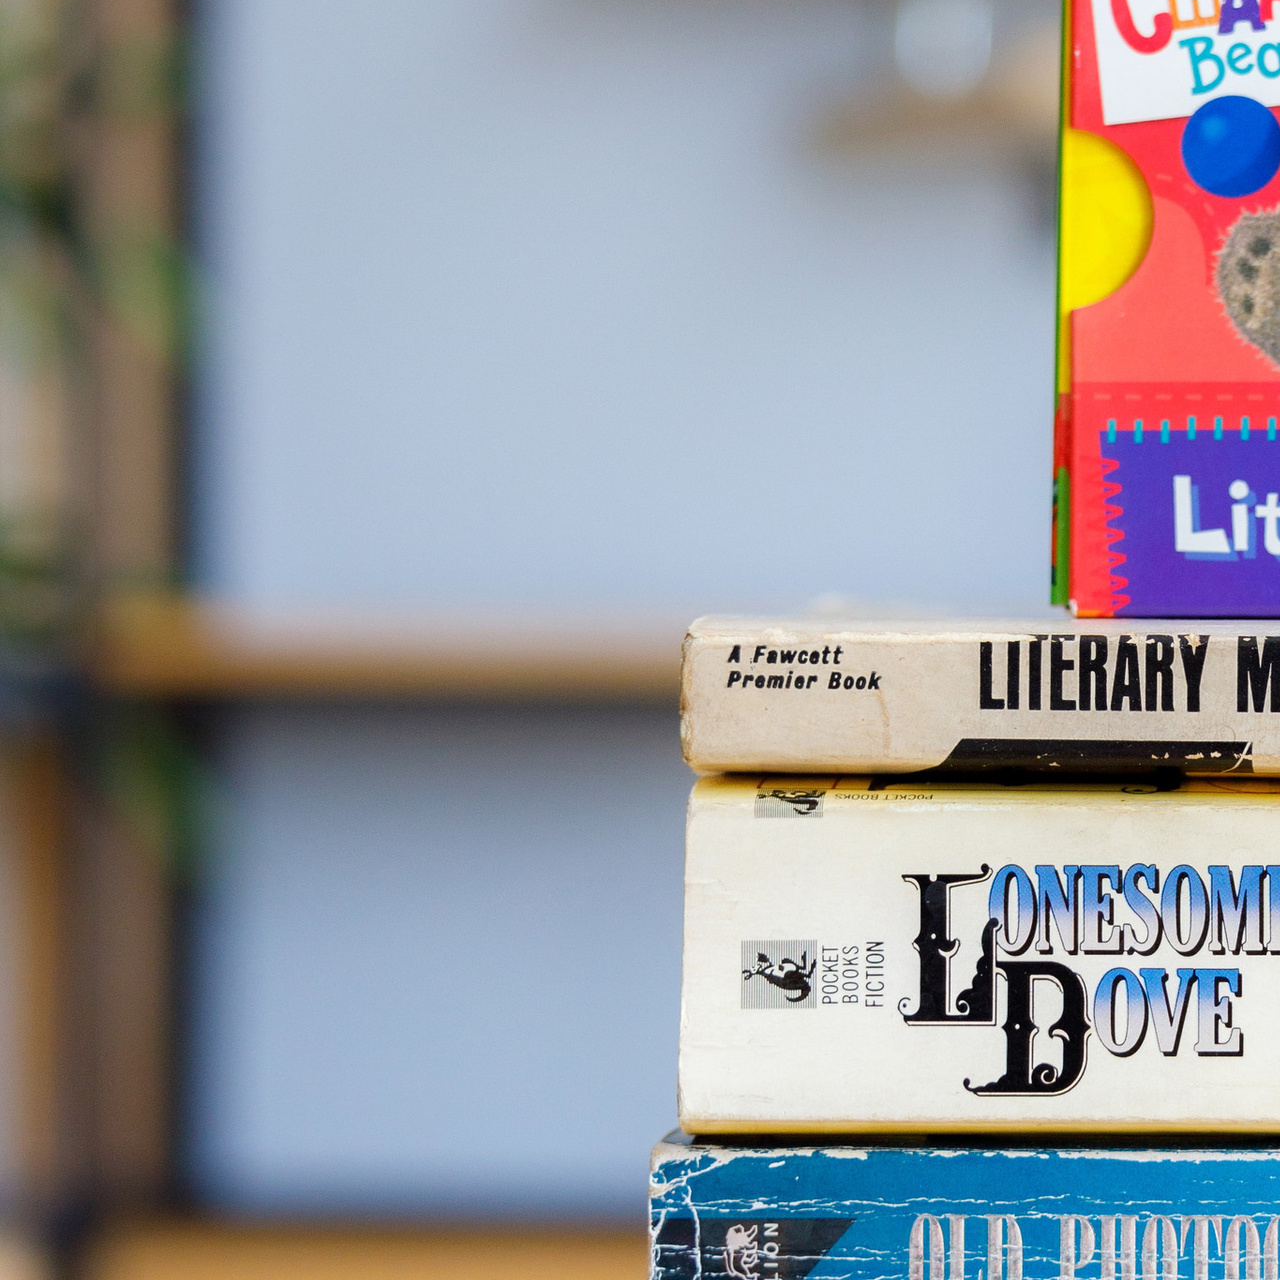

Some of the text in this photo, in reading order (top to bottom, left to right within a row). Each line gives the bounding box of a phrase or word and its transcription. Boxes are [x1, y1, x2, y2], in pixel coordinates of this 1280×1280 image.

[727, 645, 844, 665] A Fawcett
[727, 670, 882, 690] Premier Book
[978, 634, 1210, 712] LITERARY
[821, 945, 840, 1005] POCKET
[841, 944, 860, 1004] BOOKS
[864, 940, 885, 1008] FICTION
[962, 959, 1244, 1097] DOVE
